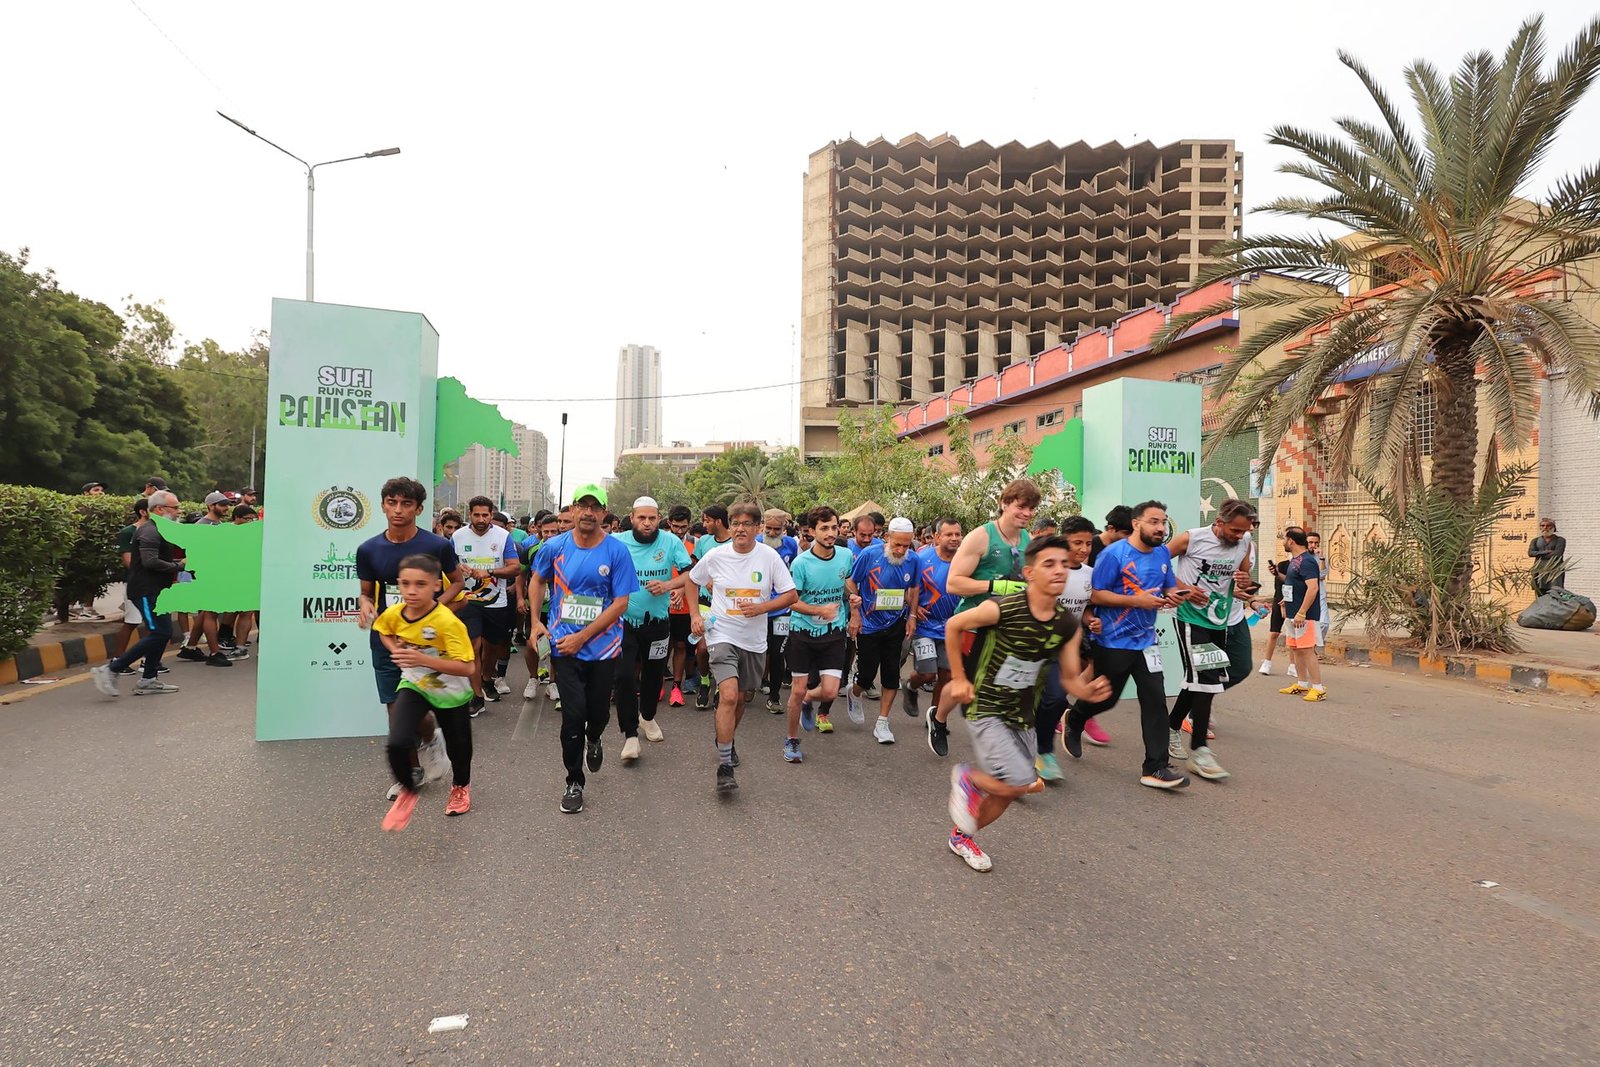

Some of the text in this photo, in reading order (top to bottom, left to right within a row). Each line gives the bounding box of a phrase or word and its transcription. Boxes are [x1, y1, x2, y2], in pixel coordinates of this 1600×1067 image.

[318, 365, 372, 389] SUFI
[318, 386, 372, 398] RUN FOR
[280, 394, 406, 436] PAKISTAN
[1148, 426, 1177, 443] SUFI
[1128, 448, 1194, 477] PAKISTAN
[312, 572, 359, 580] PAKISTA
[813, 595, 841, 604] RUNNERS
[880, 596, 899, 606] 4071
[303, 597, 360, 618] KARAC
[568, 605, 597, 620] 2046
[917, 643, 934, 655] 7273
[1200, 650, 1223, 664] 2100
